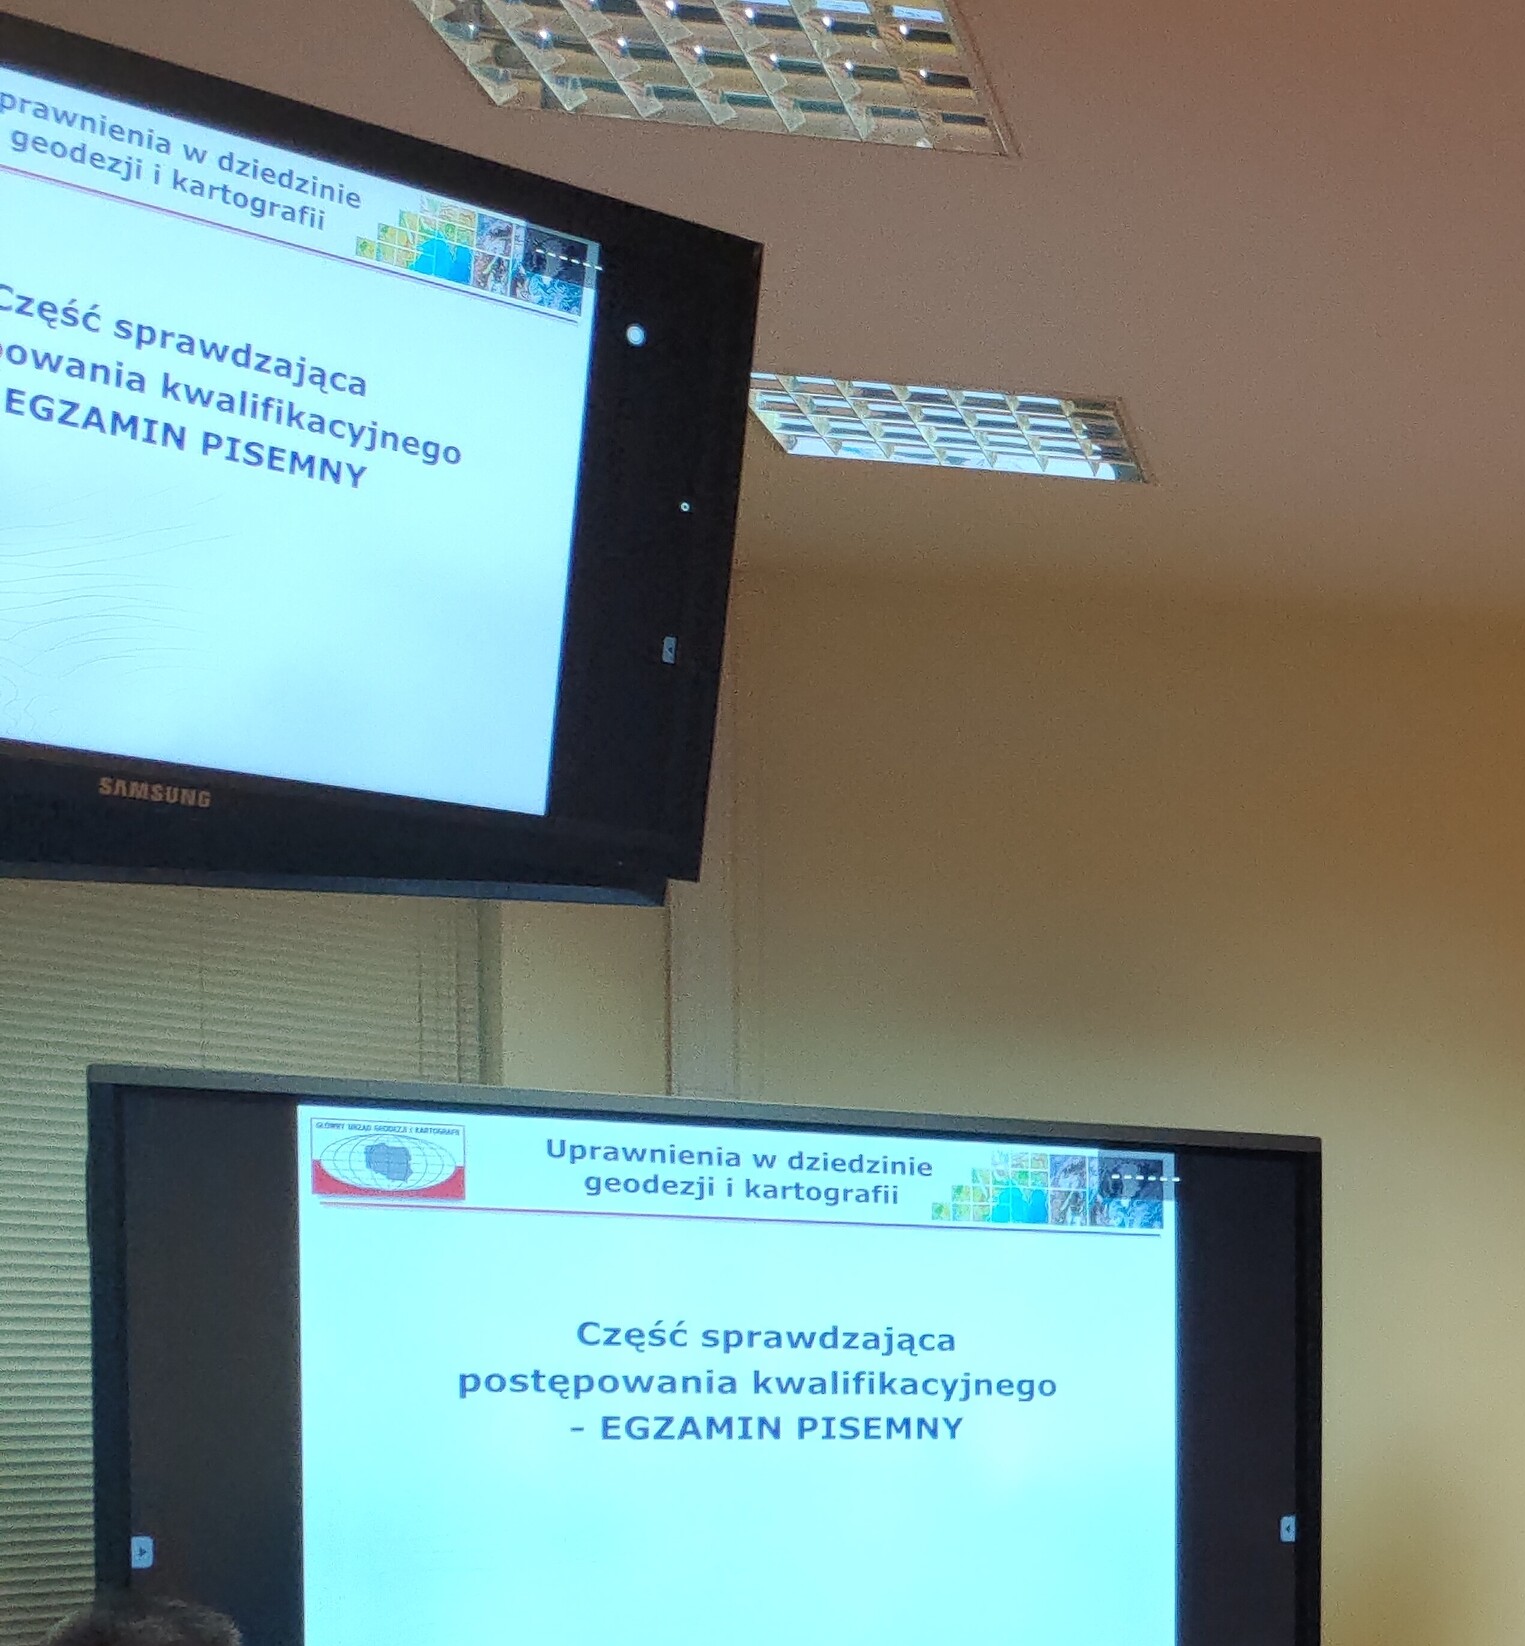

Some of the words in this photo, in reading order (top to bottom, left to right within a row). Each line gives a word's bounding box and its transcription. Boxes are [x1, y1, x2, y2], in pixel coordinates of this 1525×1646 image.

[0, 91, 171, 156] prawnienia
[182, 141, 208, 165] w
[218, 151, 363, 209] dziedzinie
[11, 128, 143, 182] geodezji
[153, 163, 161, 185] i
[172, 168, 326, 231] kartografii
[113, 317, 367, 397] sprawdzająca
[0, 342, 146, 394] owania
[161, 371, 462, 466] kwalifikacyjnego
[5, 386, 187, 451] EGZAMIN
[201, 430, 368, 489] PISEMNY
[98, 776, 211, 808] SAMSUNG
[546, 1138, 741, 1167] Uprawnienia
[753, 1153, 777, 1169] w
[788, 1151, 933, 1177] dziedzinie
[584, 1174, 715, 1201] geodezji
[726, 1177, 734, 1198] i
[745, 1178, 899, 1207] kartografii
[576, 1320, 688, 1353] Część
[701, 1325, 956, 1357] sprawdzająca
[459, 1369, 738, 1400] postępowania
[753, 1370, 1057, 1402] kwalifikacyjnego
[601, 1415, 781, 1440] EGZAMIN
[797, 1416, 964, 1440] PISEMNY
